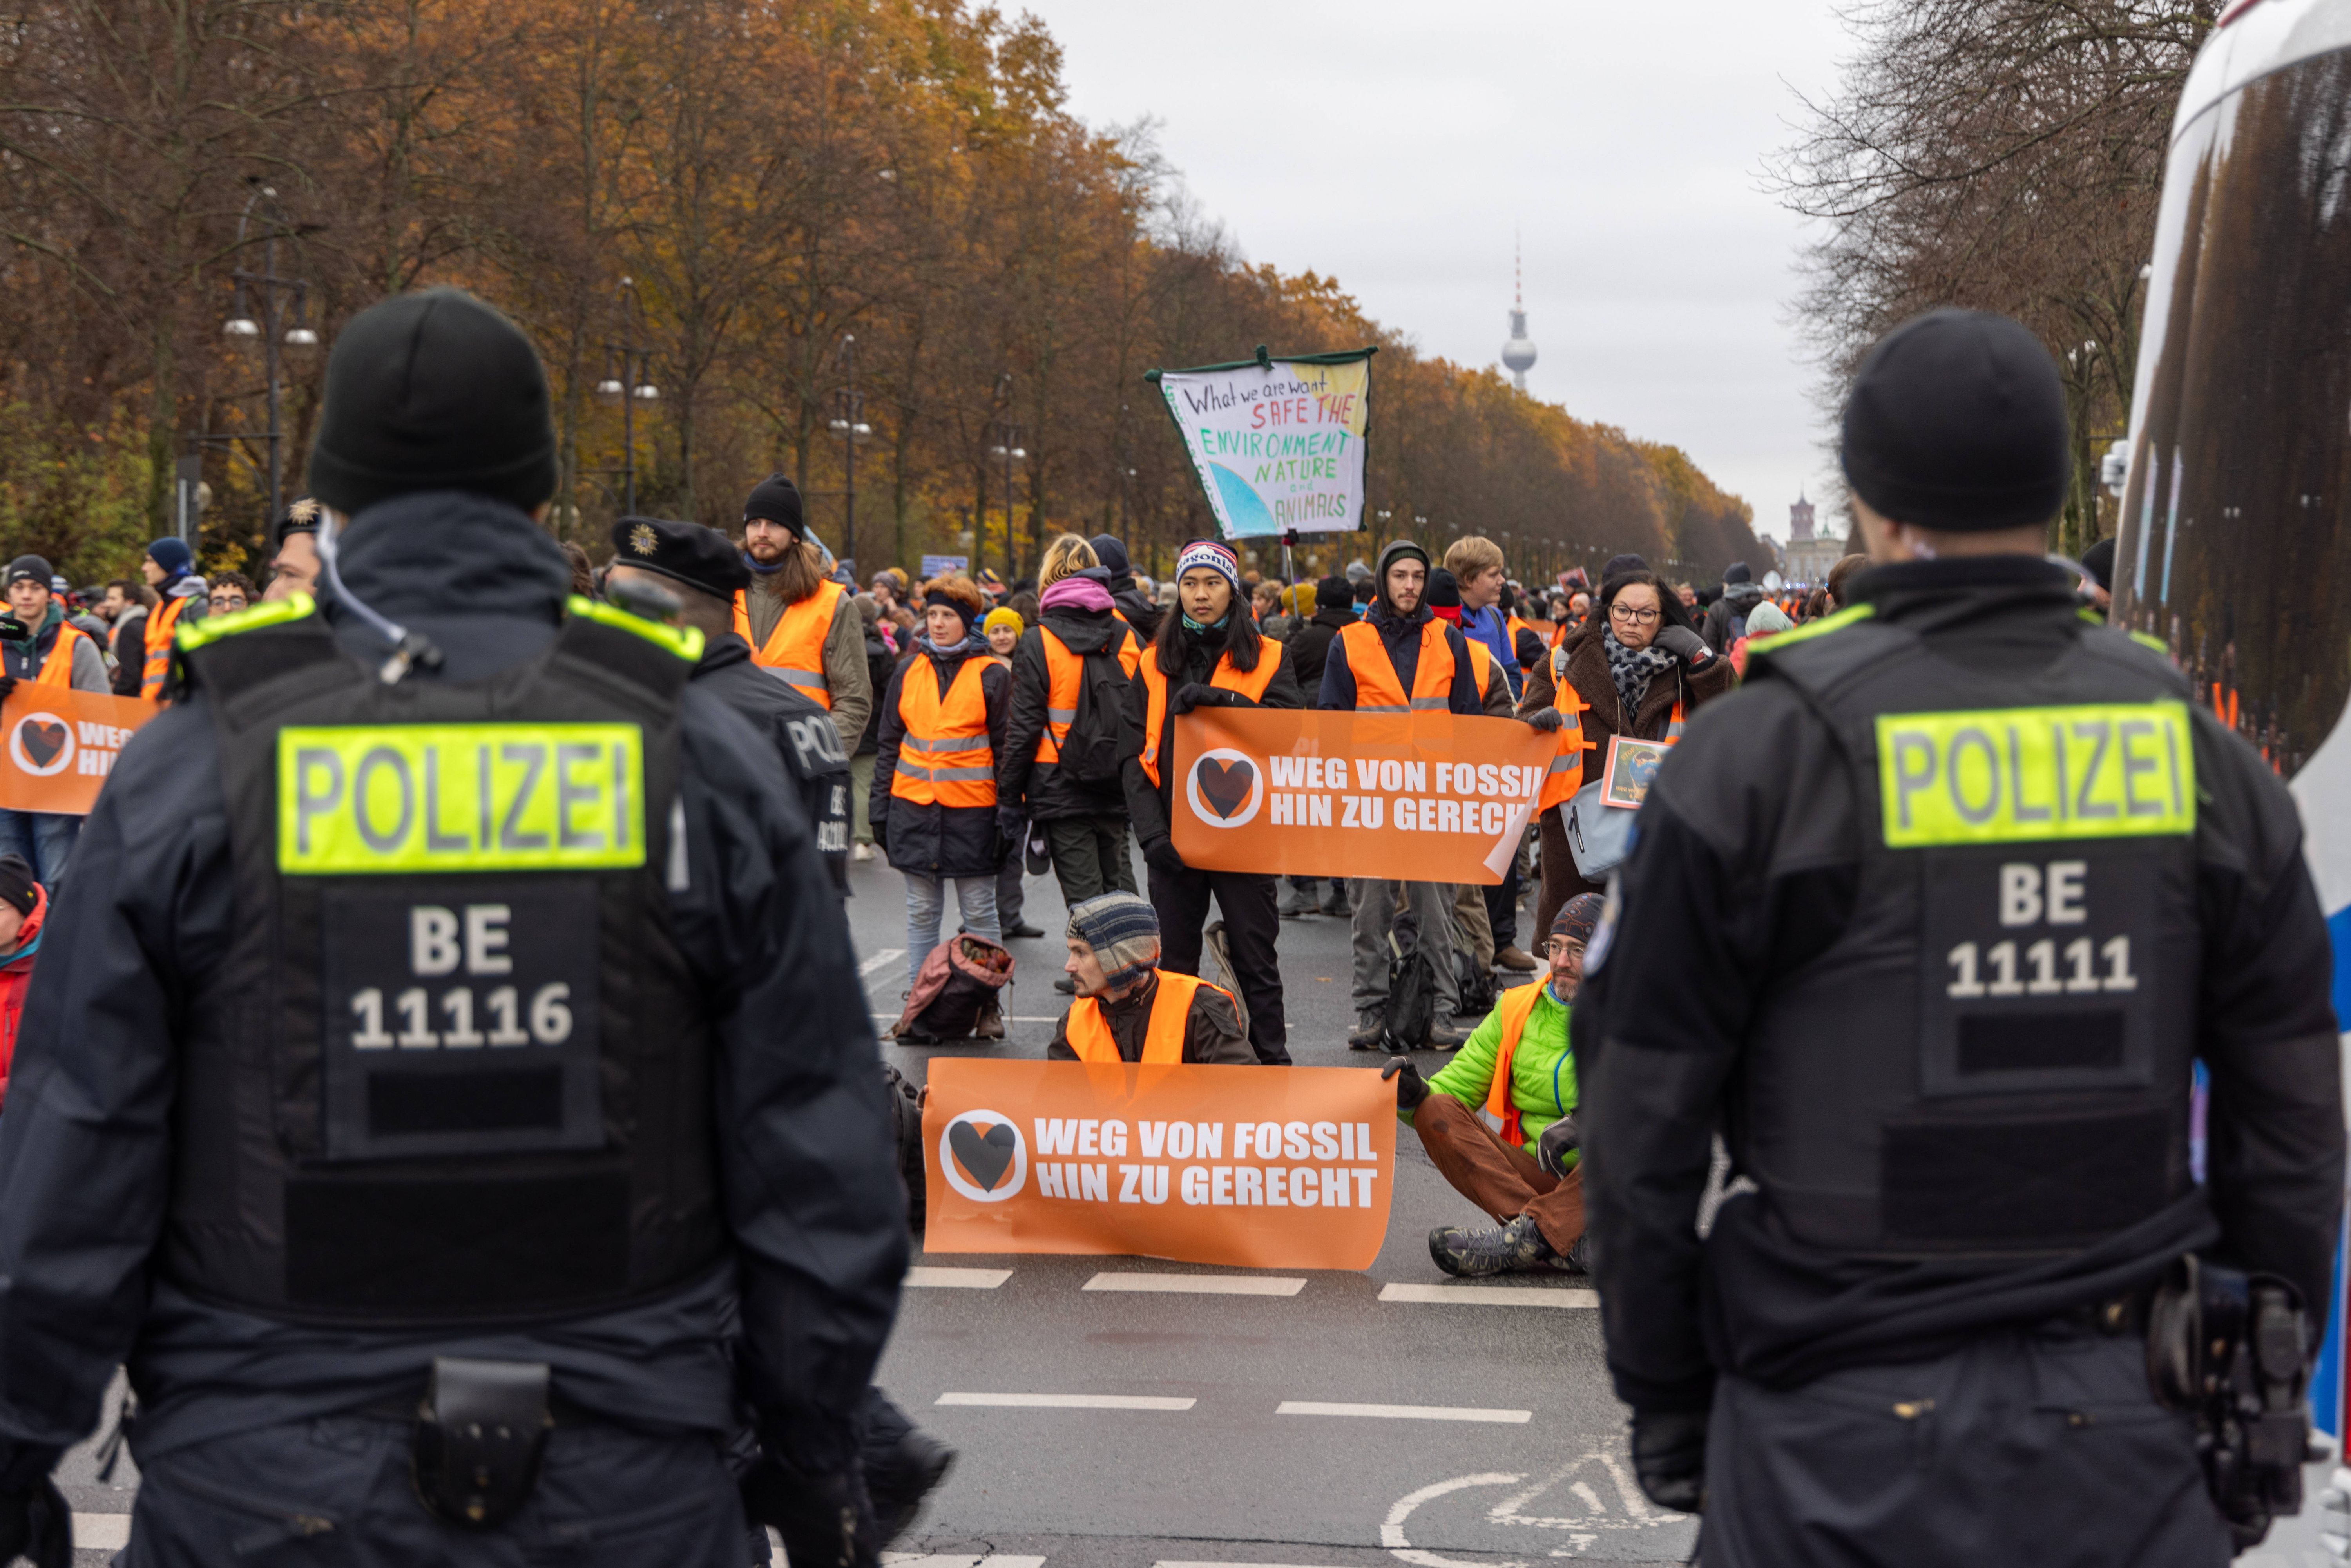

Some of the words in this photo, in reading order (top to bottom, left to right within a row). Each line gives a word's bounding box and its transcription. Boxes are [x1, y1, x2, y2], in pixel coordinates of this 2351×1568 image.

[1184, 382, 1237, 415] What
[1241, 389, 1257, 404] we
[1263, 384, 1285, 398] are
[1288, 369, 1328, 395] want
[1251, 398, 1308, 430] SAFE
[1317, 393, 1356, 425] THE
[1199, 428, 1352, 459] ENVIRONMENT
[1254, 456, 1338, 484] NATURE
[1290, 479, 1314, 494] and
[1274, 492, 1348, 527] ANIMALS
[1270, 755, 1347, 790] WEG
[1355, 759, 1426, 793] VON
[1892, 719, 2184, 830] POLIZEI
[296, 744, 630, 856] POLIZEI
[1270, 792, 1332, 827] HIN
[1340, 795, 1384, 829] ZU
[1393, 797, 1526, 836] GERECH
[1999, 860, 2088, 927] BE
[410, 904, 513, 976] BE
[1946, 935, 2138, 998] 11111
[351, 981, 573, 1050] 11116
[1034, 1117, 1128, 1157] WEG
[1138, 1120, 1223, 1160] VON
[1233, 1121, 1377, 1161] FOSSIL
[1035, 1162, 1108, 1203] HIN
[1119, 1164, 1169, 1205] ZU
[1181, 1165, 1378, 1208] GERECHT
